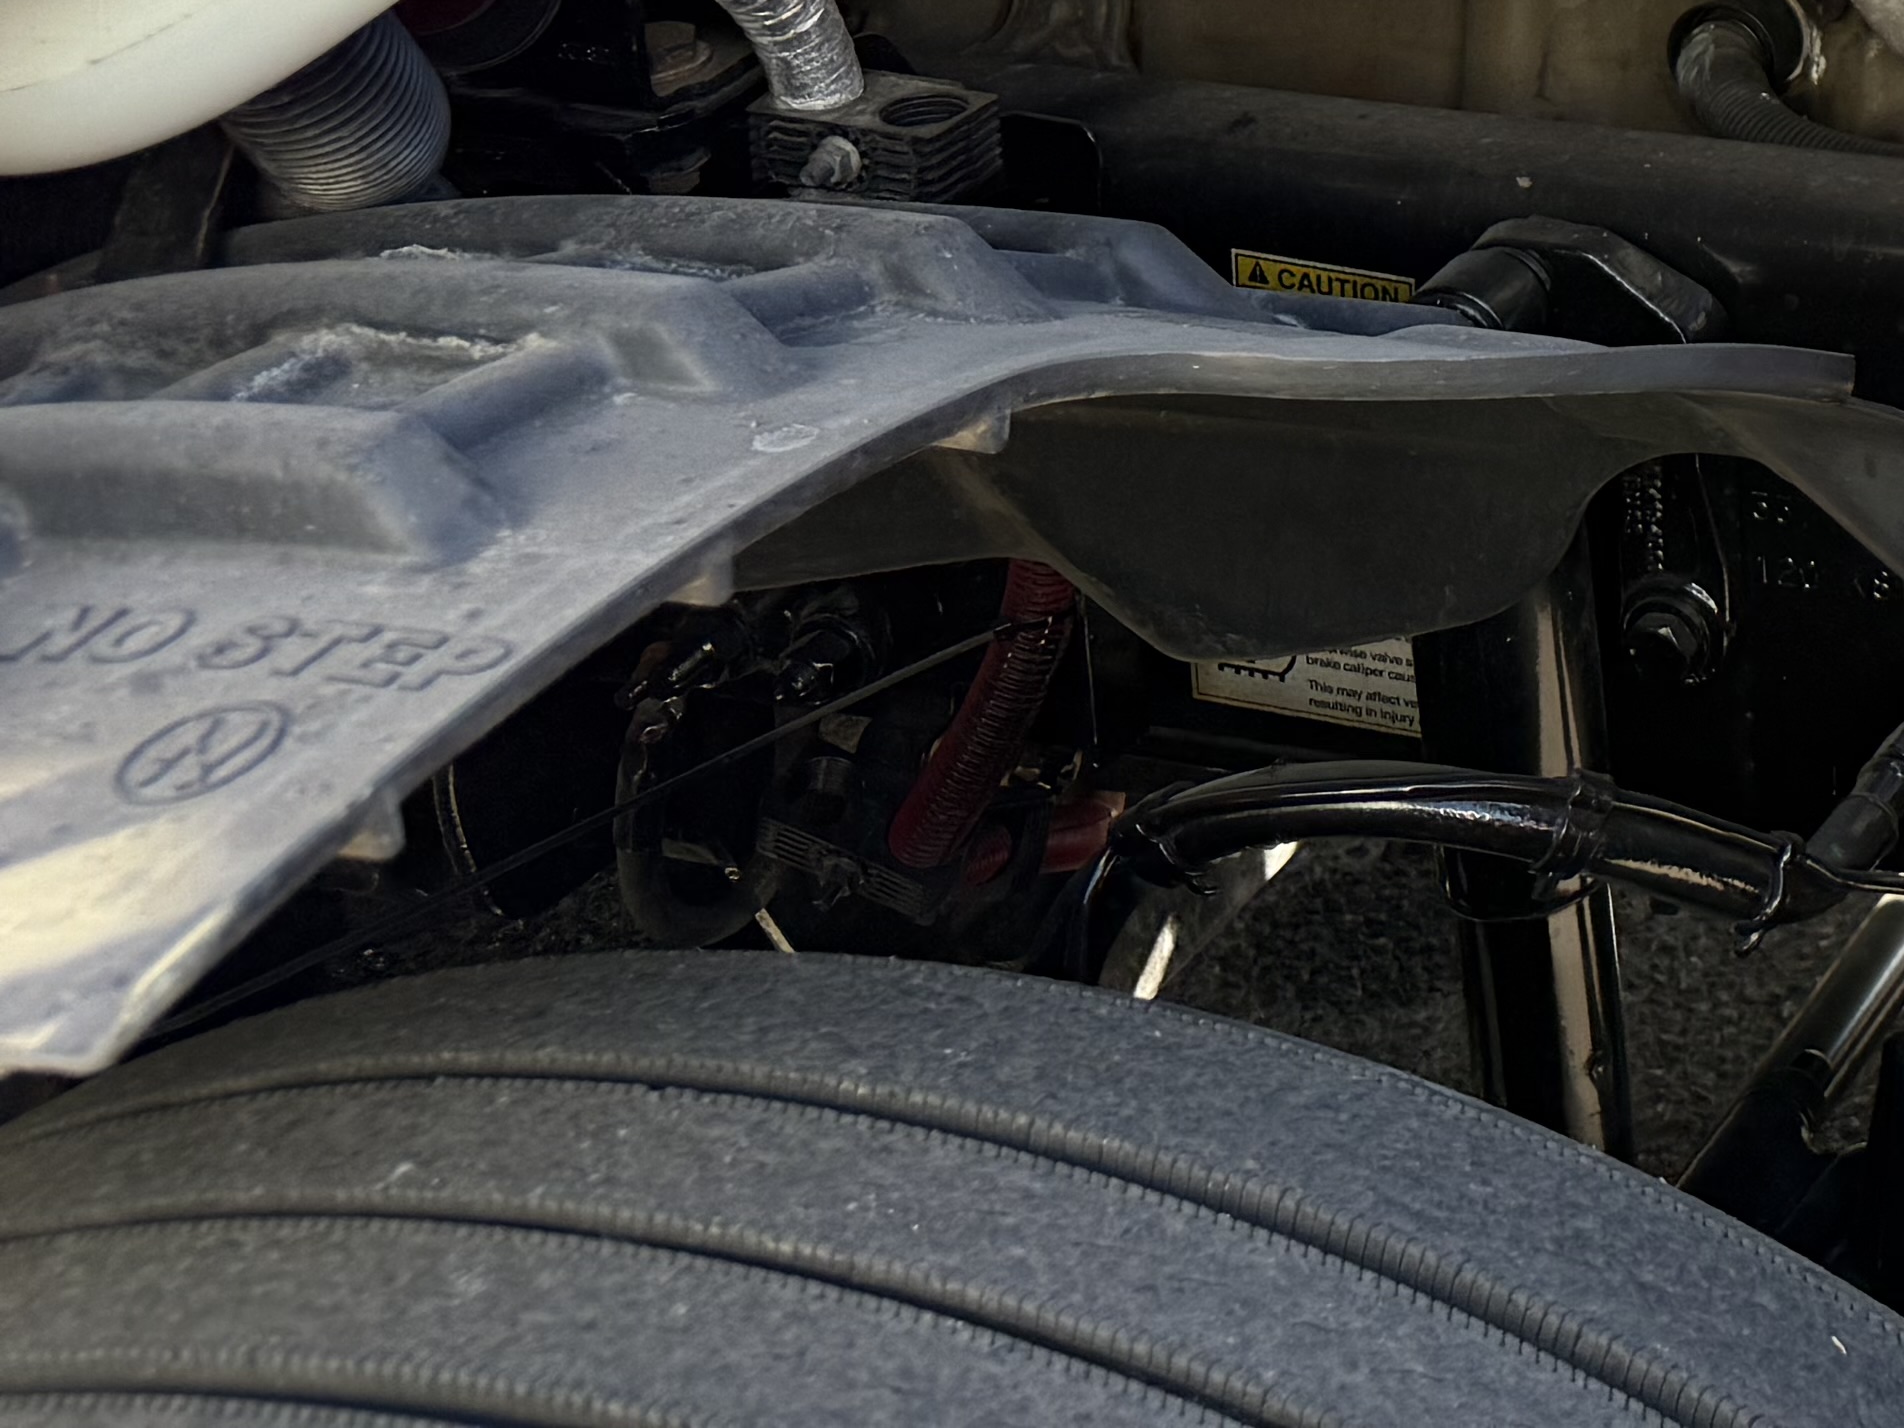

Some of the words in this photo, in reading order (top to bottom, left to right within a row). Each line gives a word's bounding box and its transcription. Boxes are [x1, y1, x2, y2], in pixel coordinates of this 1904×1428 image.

[1277, 268, 1398, 303] CAUTION
[0, 605, 197, 664] NO
[196, 613, 514, 691] STEP
[1306, 655, 1341, 670] brake
[1343, 660, 1385, 678] caliper
[1387, 670, 1416, 684] caus
[1308, 678, 1334, 694] This
[1336, 685, 1363, 701] may
[1365, 689, 1400, 706] affect
[1308, 696, 1364, 718] resulting
[1365, 704, 1377, 719] in
[1380, 707, 1415, 727] injury
